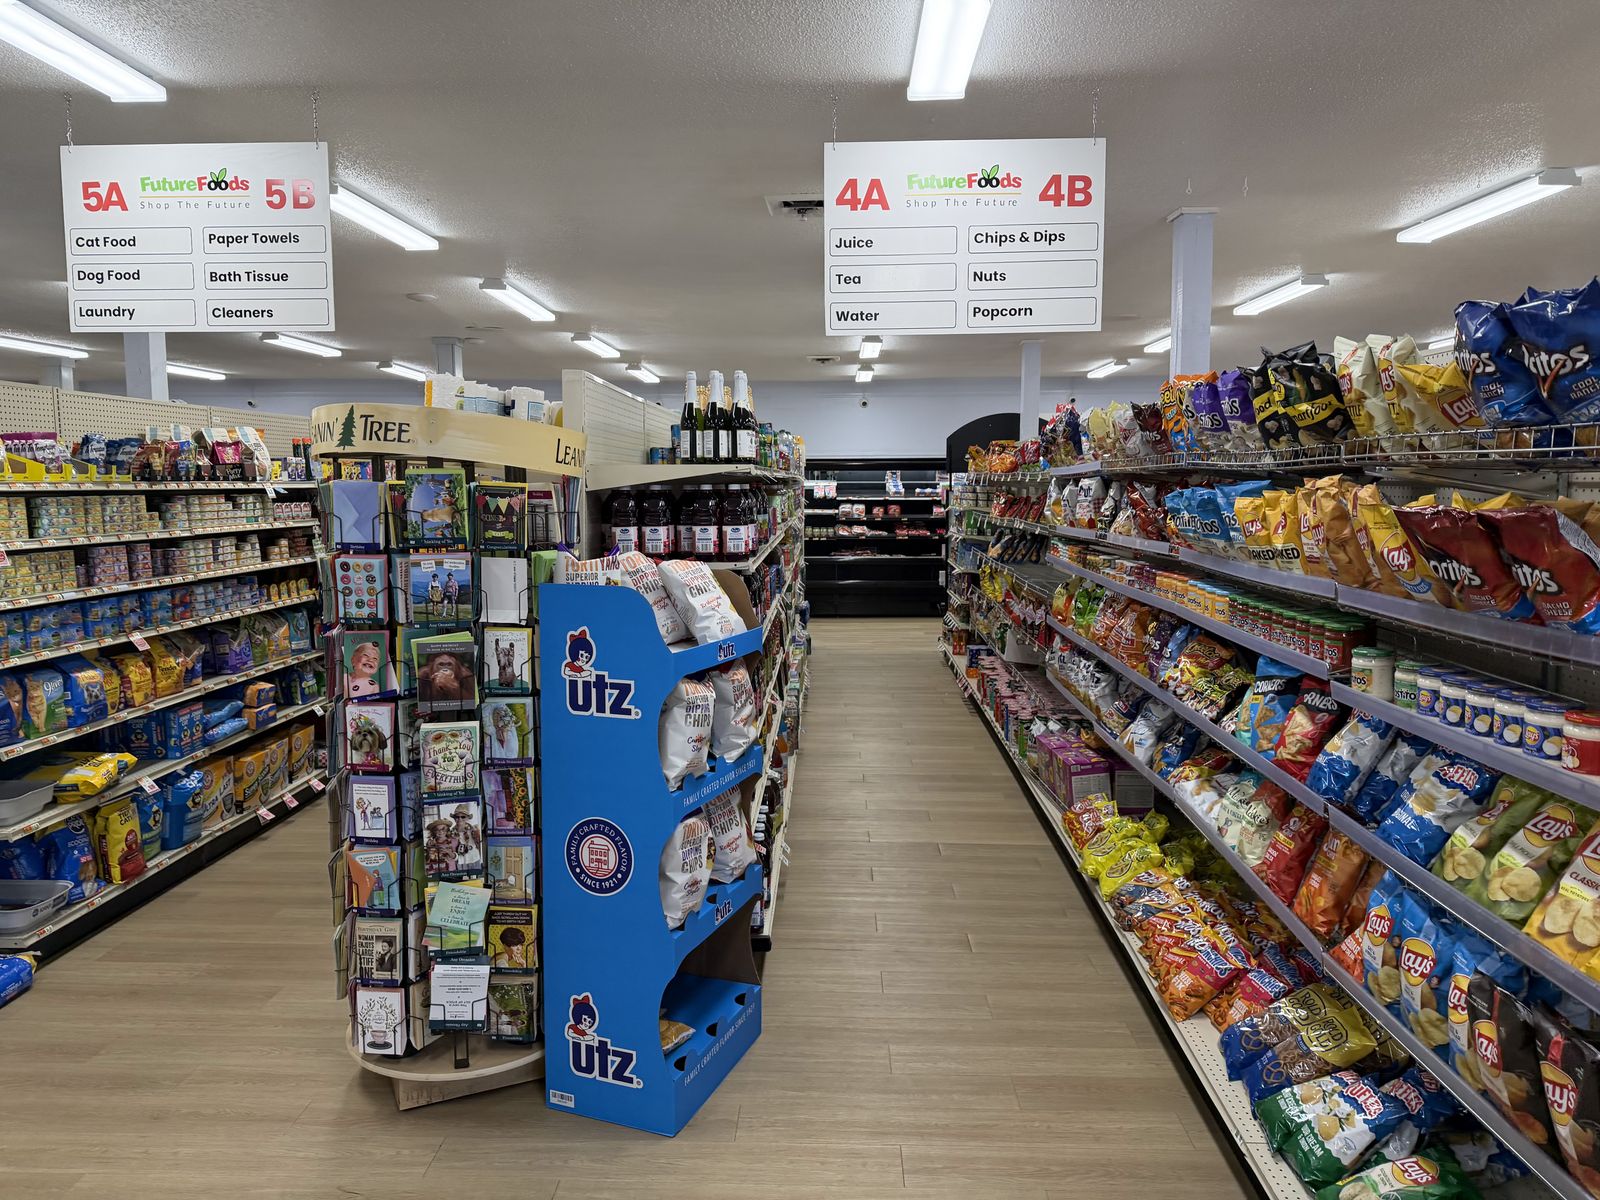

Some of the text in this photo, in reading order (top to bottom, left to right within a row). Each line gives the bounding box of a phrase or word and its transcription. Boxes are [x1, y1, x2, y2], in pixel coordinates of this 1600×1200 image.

[140, 174, 249, 192] FutureFoods
[907, 172, 1022, 190] FutureFoods
[82, 182, 128, 212] 5A
[266, 179, 316, 209] 5B
[835, 178, 890, 211] 4A
[1038, 174, 1093, 207] 4B
[140, 200, 250, 210] Shop The Future
[906, 198, 1018, 208] Shop The Future
[75, 236, 136, 248] Cat Food
[208, 232, 300, 245] Paper Towels
[835, 237, 873, 248] Juice
[974, 231, 1066, 247] Chips & Dips
[77, 270, 140, 284] Dog Food
[210, 270, 289, 282] Bath Tissue
[835, 273, 861, 285] Tea
[972, 271, 1006, 282] Nuts
[79, 306, 135, 320] Laundry
[212, 307, 273, 319] Cleaners
[835, 310, 879, 322] Water
[972, 305, 1033, 321] Popcorn
[359, 414, 411, 444] TREE
[565, 573, 599, 582] SUPERIOR
[682, 573, 710, 587] DIPPING
[688, 579, 718, 598] CHIPS
[684, 713, 711, 727] CHIPS
[428, 742, 471, 758] Thank You
[426, 768, 474, 784] EVERYTHING
[683, 759, 757, 808] FAMILY CRAFTED FLAVOR SINCE 1921
[710, 805, 737, 826] DIPPING
[711, 815, 740, 838] CHIPS
[1524, 811, 1574, 841] Lay's
[570, 823, 628, 872] FAMILY CRAFTED FLAVOR
[681, 855, 703, 874] CHIPS
[579, 873, 618, 889] SINCE 1921
[451, 897, 471, 906] DREAM
[440, 917, 470, 927] CELEBRATE
[1366, 911, 1391, 937] Lay's
[358, 941, 374, 949] ENJOYS
[359, 957, 374, 967] STIFF
[1401, 946, 1434, 977] Lay's
[1300, 990, 1322, 1017] ROLD
[1322, 1016, 1344, 1042] ROLD
[1307, 1131, 1325, 1158] CREAM
[1394, 1158, 1433, 1185] Lay's
